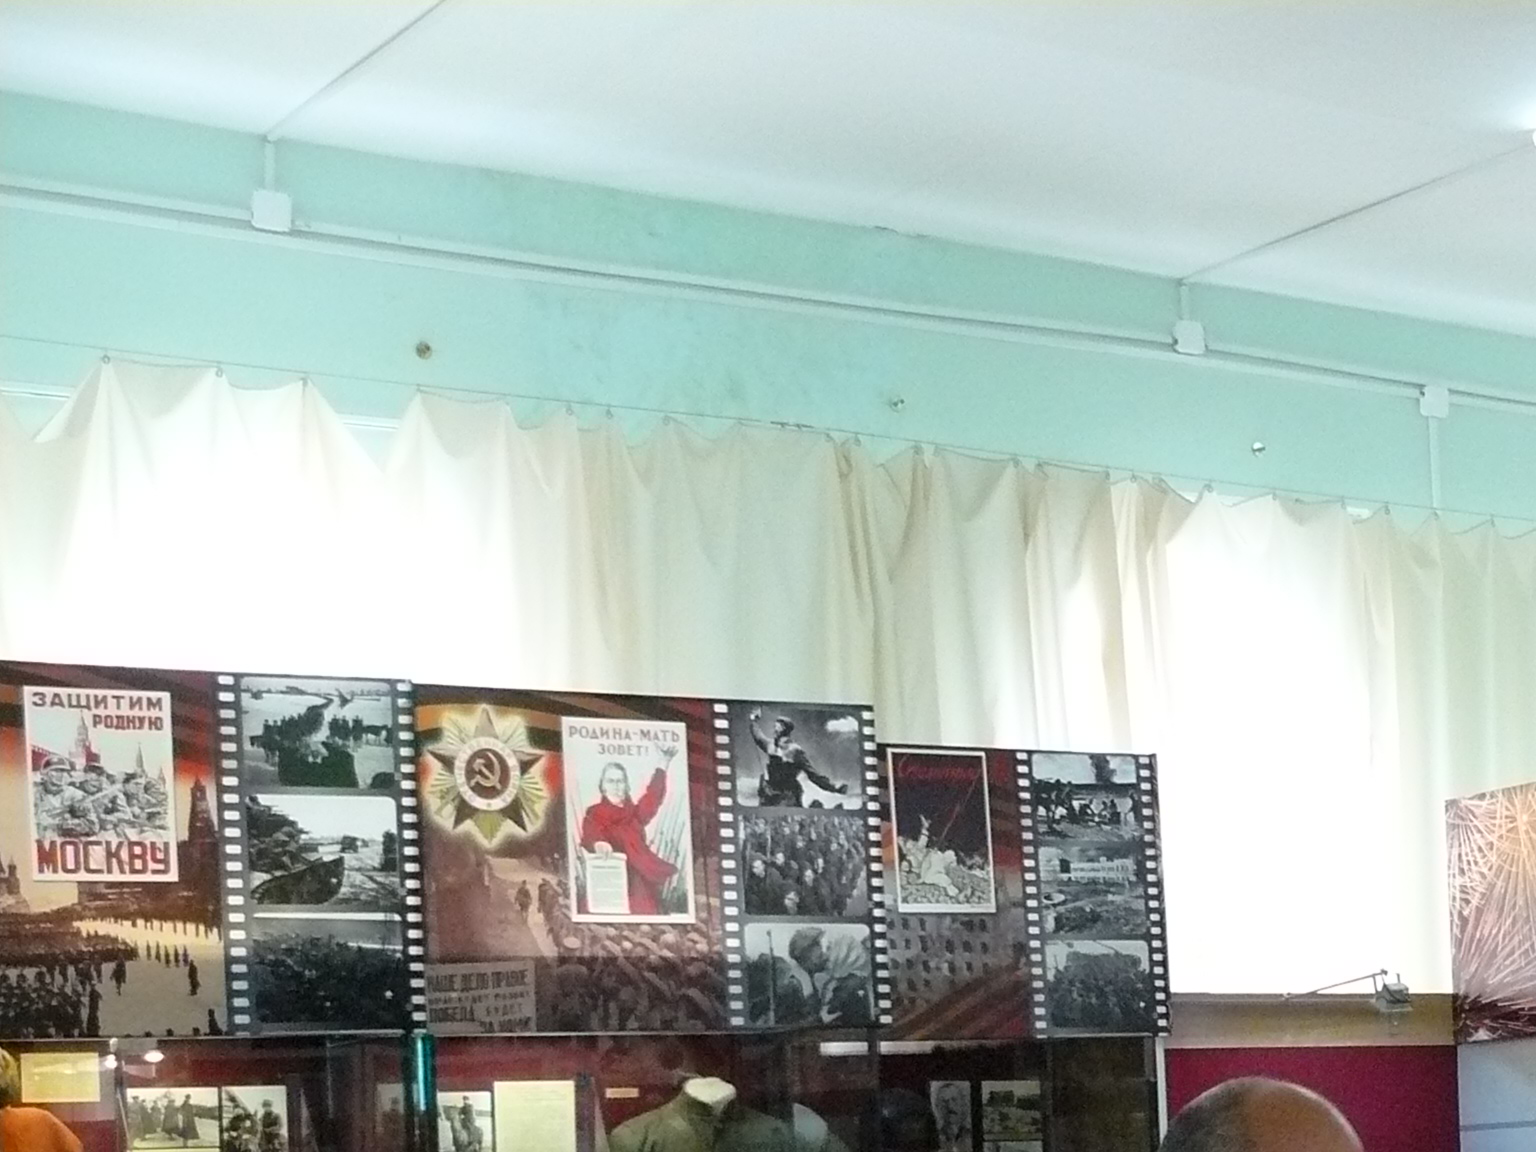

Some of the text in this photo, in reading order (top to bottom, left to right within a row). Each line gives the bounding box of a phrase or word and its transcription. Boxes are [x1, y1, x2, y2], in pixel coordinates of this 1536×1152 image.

[32, 691, 163, 711] ЗАЩИТИМ
[92, 714, 164, 731] РОДНУЮ
[568, 725, 680, 742] РОДИНА-МАТЬ
[598, 743, 649, 756] ЗОВЕТ!
[35, 839, 171, 875] МОСКВУ
